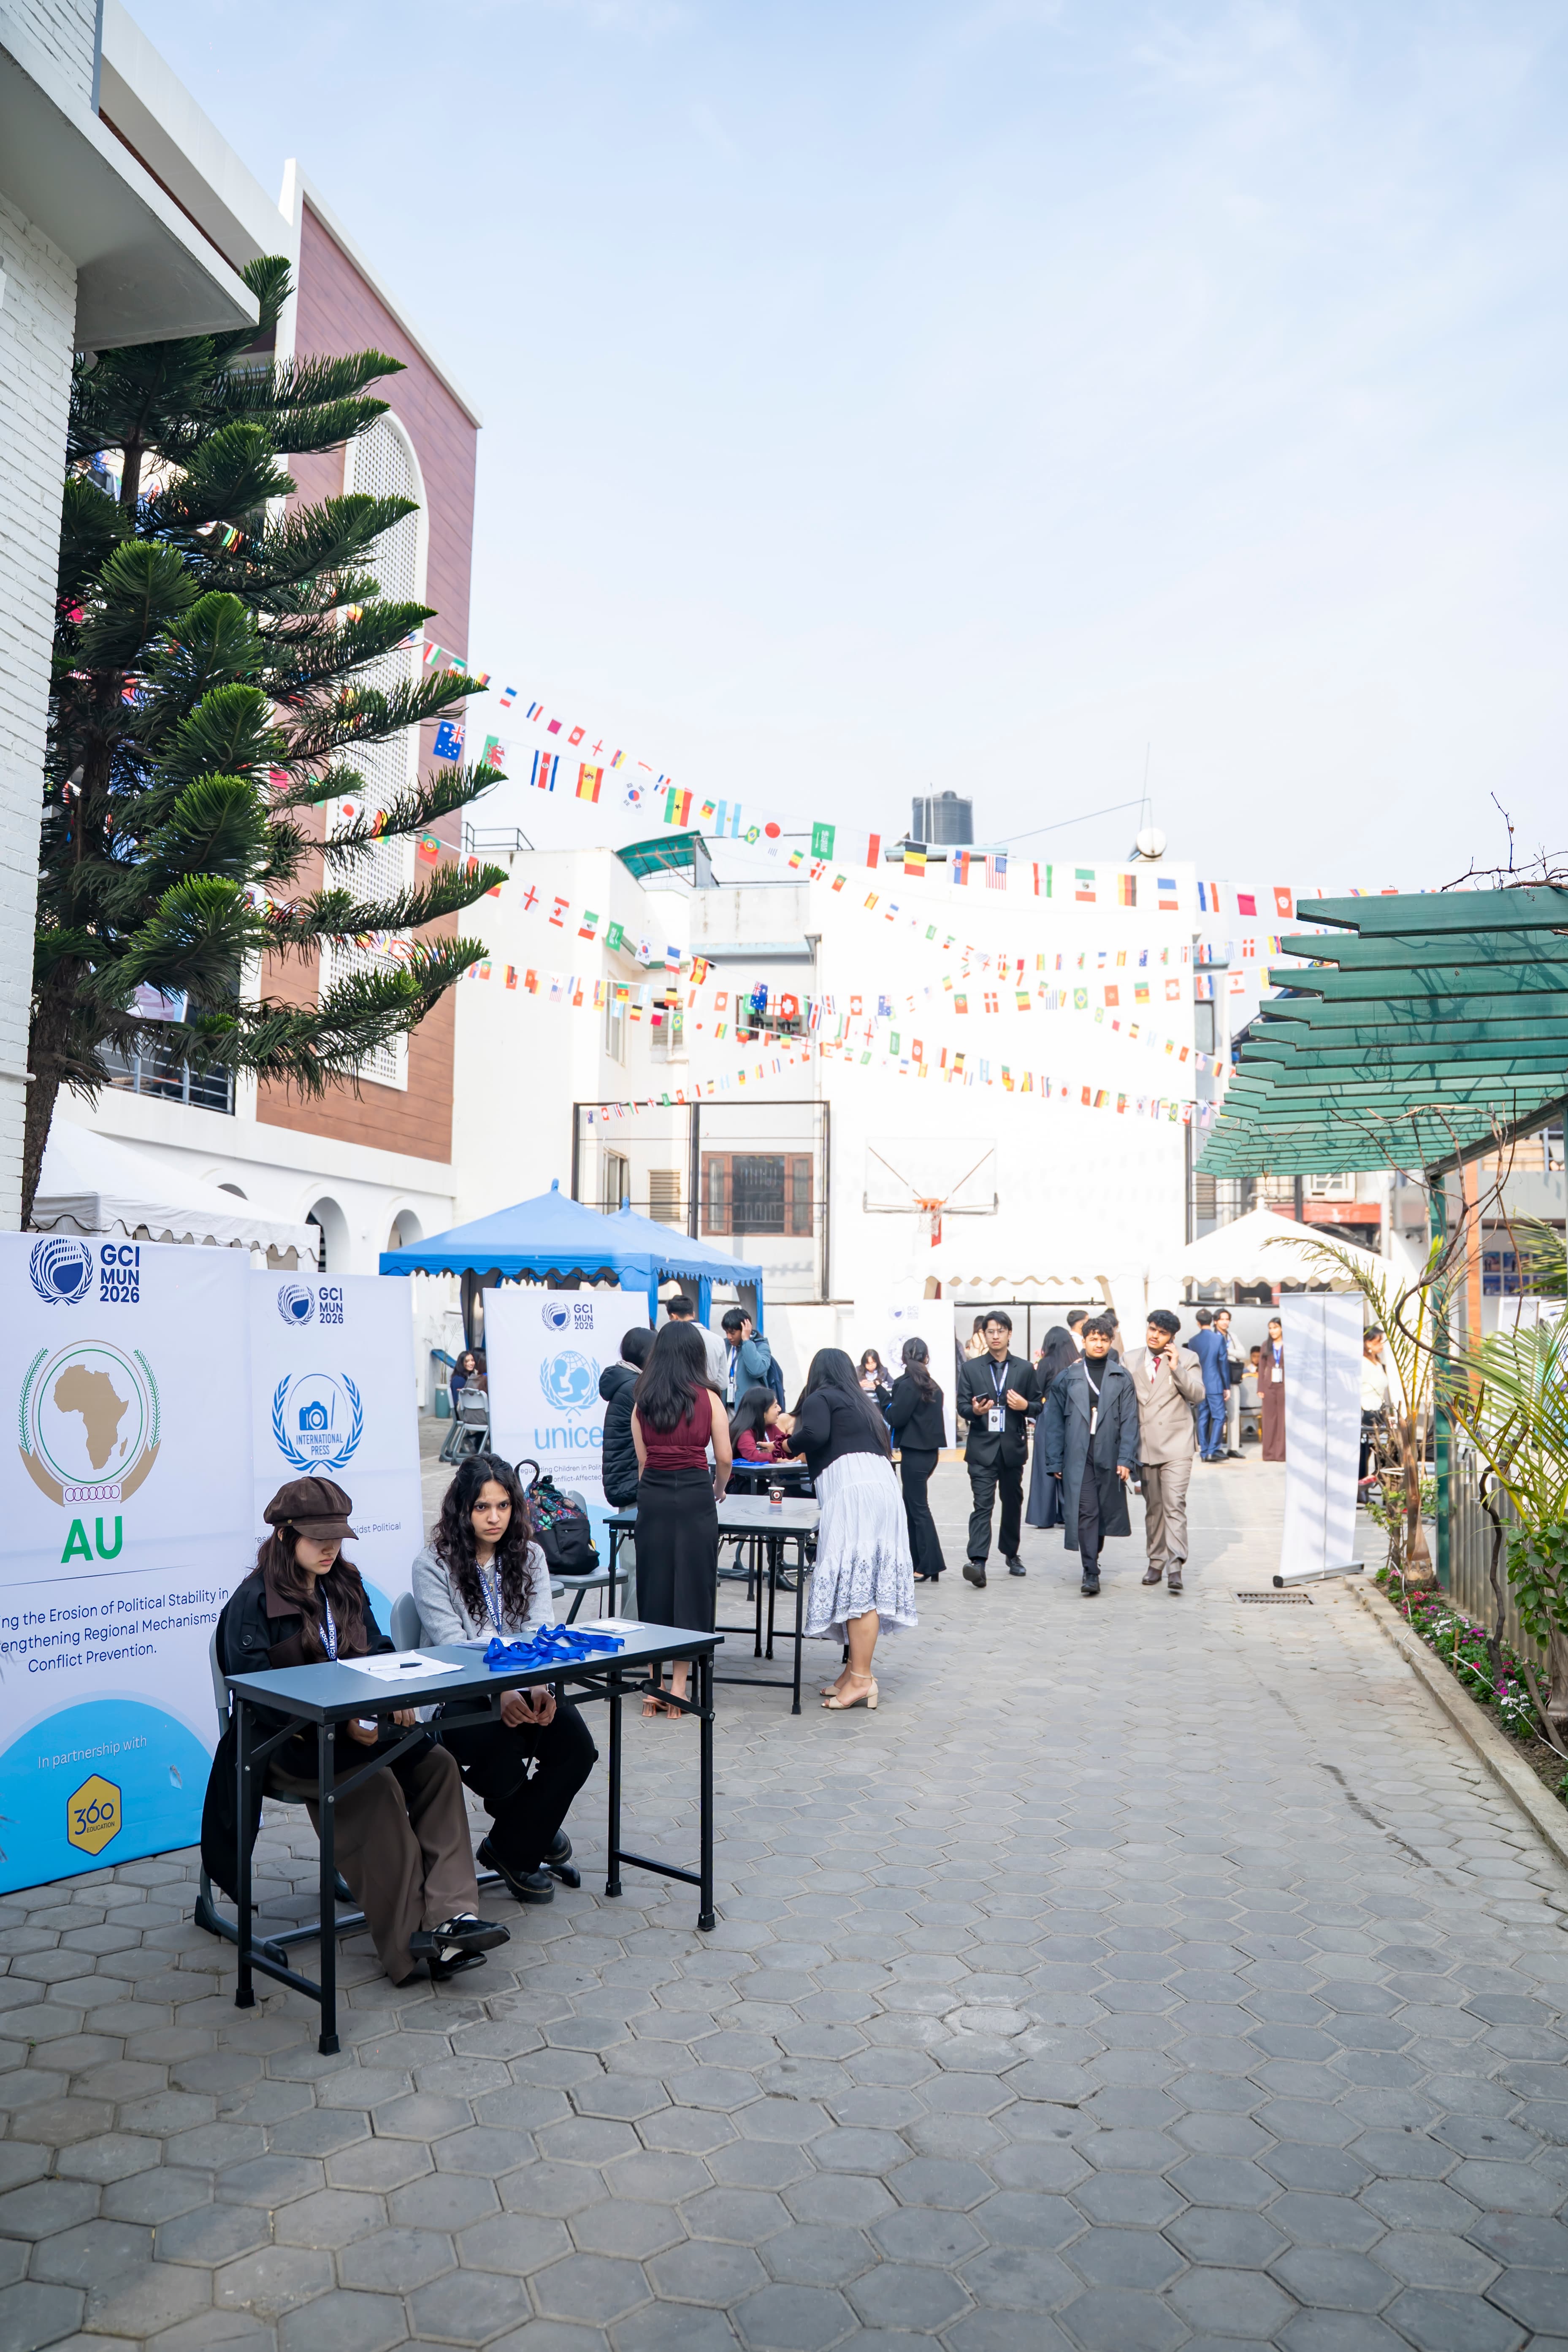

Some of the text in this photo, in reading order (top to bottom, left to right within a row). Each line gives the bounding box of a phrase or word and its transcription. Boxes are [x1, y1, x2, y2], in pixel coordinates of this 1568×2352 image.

[100, 1244, 140, 1267] GCI
[101, 1268, 139, 1286] MUN
[100, 1285, 140, 1303] 2026
[319, 1287, 342, 1301] GCI
[320, 1302, 343, 1313] MUN
[574, 1304, 592, 1313] GCI
[320, 1313, 344, 1324] 2026
[574, 1322, 594, 1330] 2026
[296, 1433, 343, 1445] INTERNATIONAL
[534, 1419, 603, 1450] unice
[311, 1445, 330, 1455] PRESS
[553, 1474, 602, 1482] onflict-Affected
[373, 1521, 401, 1532] Political
[60, 1515, 123, 1563] AU
[23, 1611, 46, 1625] the
[50, 1605, 97, 1622] Erosion
[101, 1601, 114, 1615] of
[118, 1595, 165, 1613] Political
[169, 1589, 216, 1606] Stability
[219, 1588, 229, 1600] in
[485, 1594, 495, 1615] MODEL
[84, 1620, 138, 1642] Regional
[143, 1612, 217, 1632] Mechanisms
[28, 1643, 157, 1672] Conflict Prevention.
[38, 1735, 147, 1769] In partnership with
[87, 1821, 115, 1833] EDUCATION
